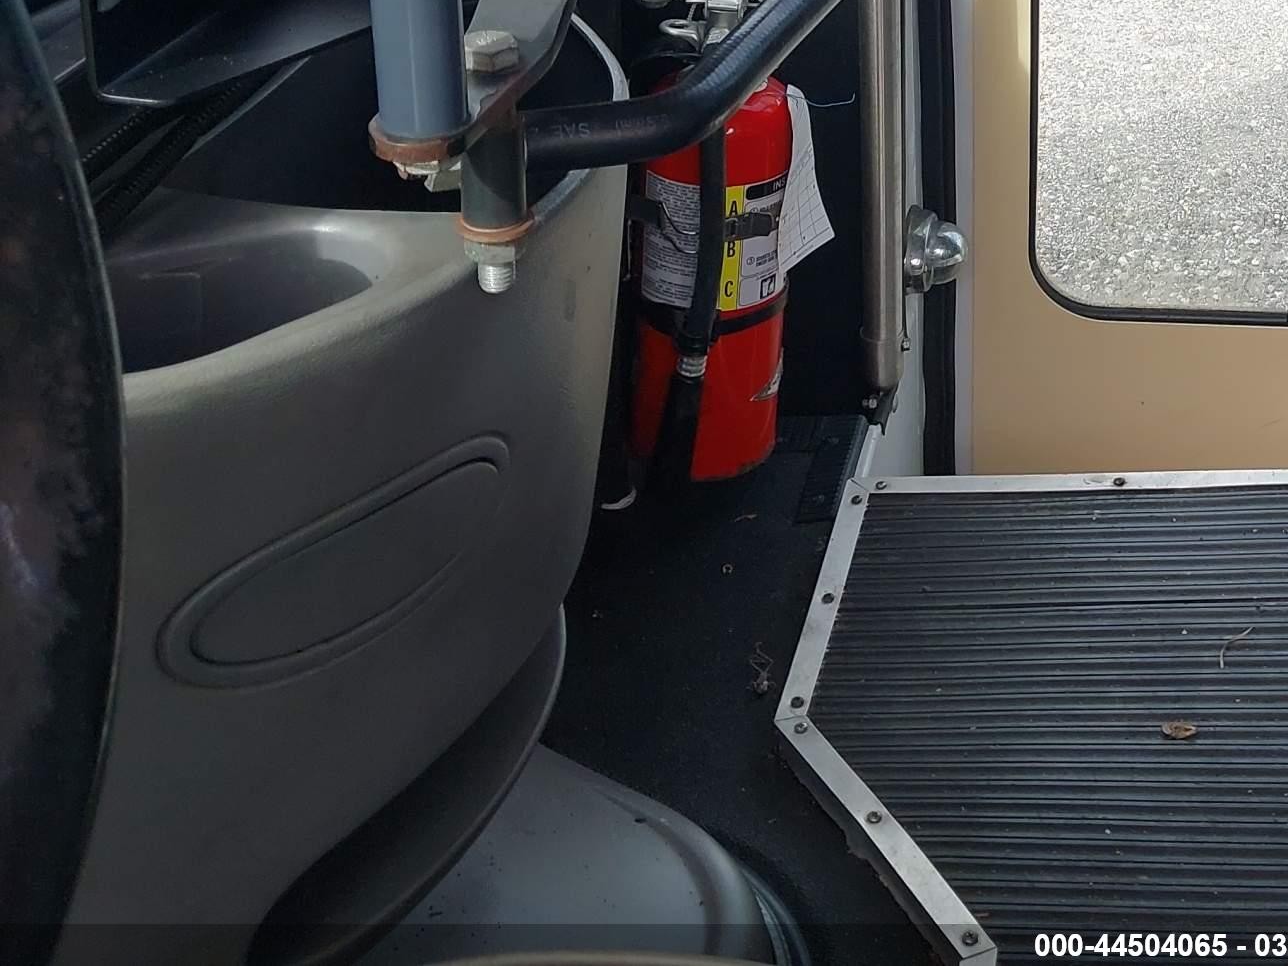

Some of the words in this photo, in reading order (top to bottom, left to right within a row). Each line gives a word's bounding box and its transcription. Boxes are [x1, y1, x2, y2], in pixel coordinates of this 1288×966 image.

[772, 177, 786, 191] INS
[729, 200, 738, 218] A
[727, 241, 736, 258] B
[724, 280, 734, 298] C
